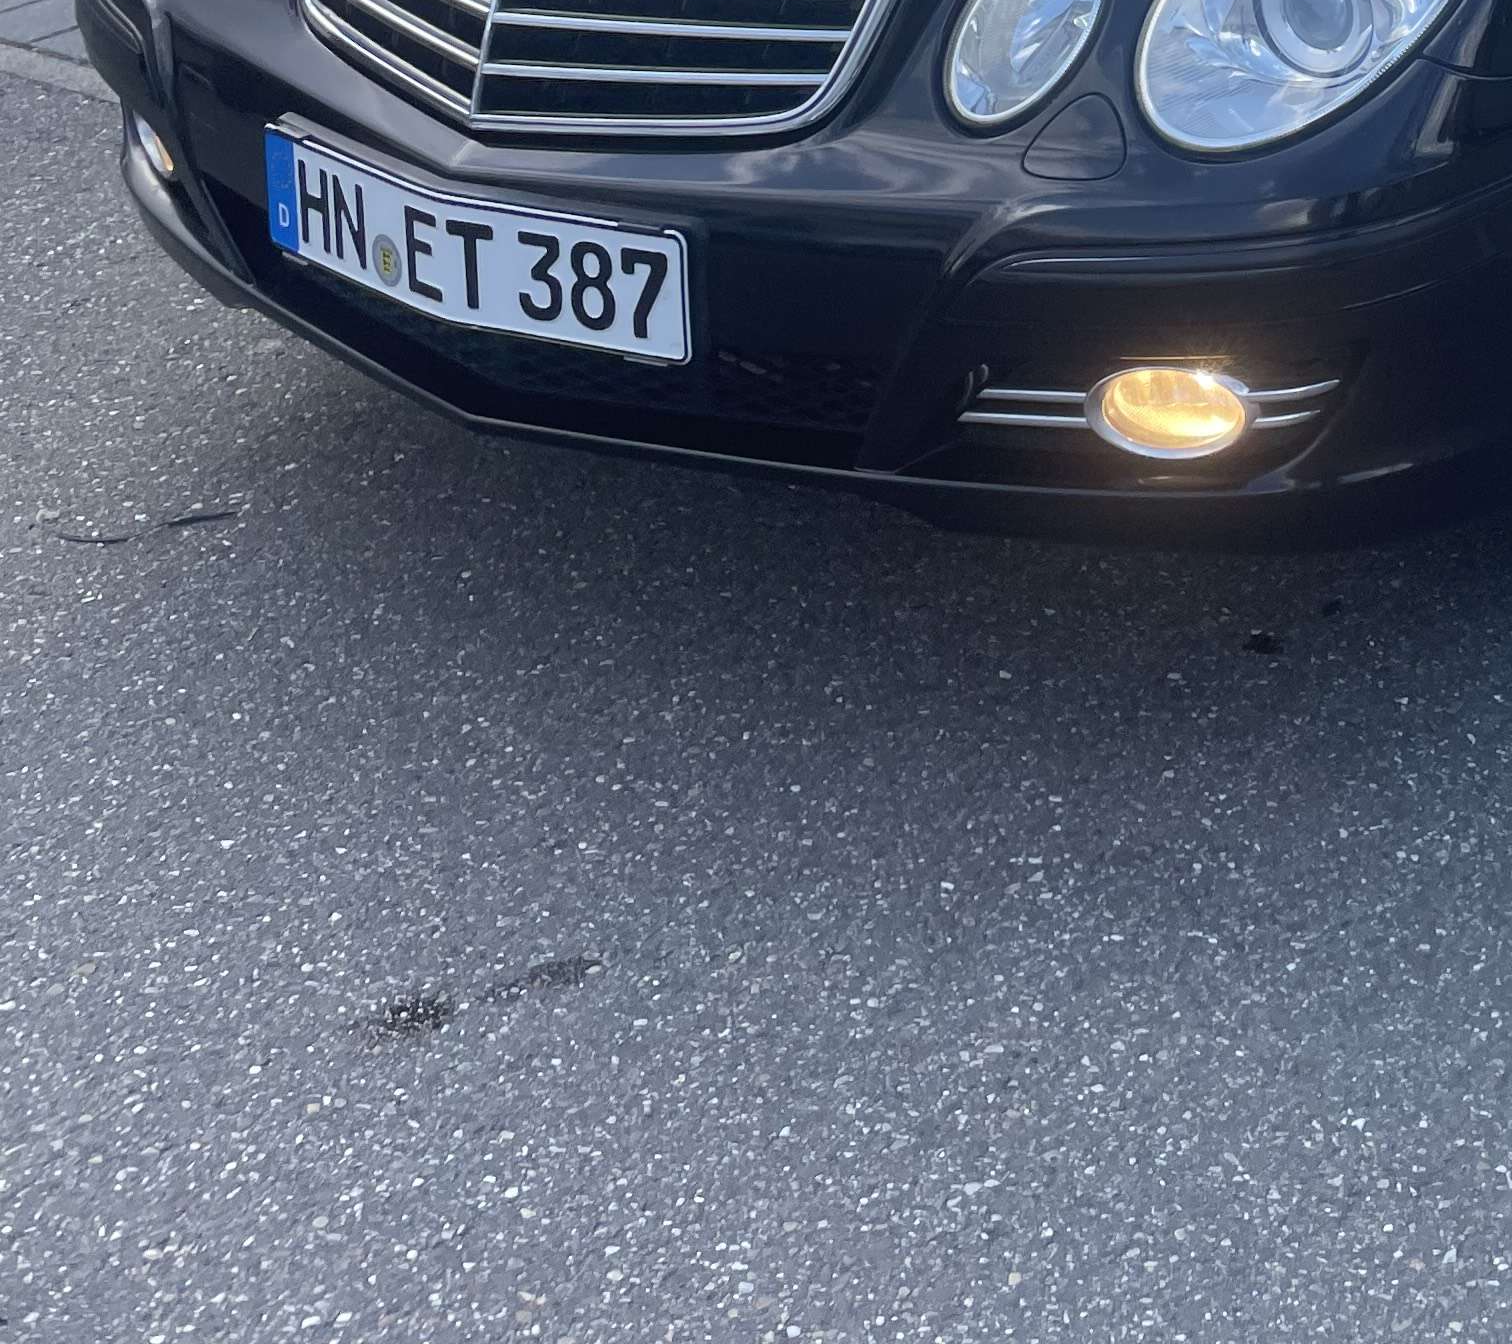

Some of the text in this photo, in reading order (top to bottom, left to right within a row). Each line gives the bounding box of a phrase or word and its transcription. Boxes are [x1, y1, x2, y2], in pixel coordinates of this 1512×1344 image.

[278, 202, 290, 228] D
[297, 158, 669, 340] HN ET 387
